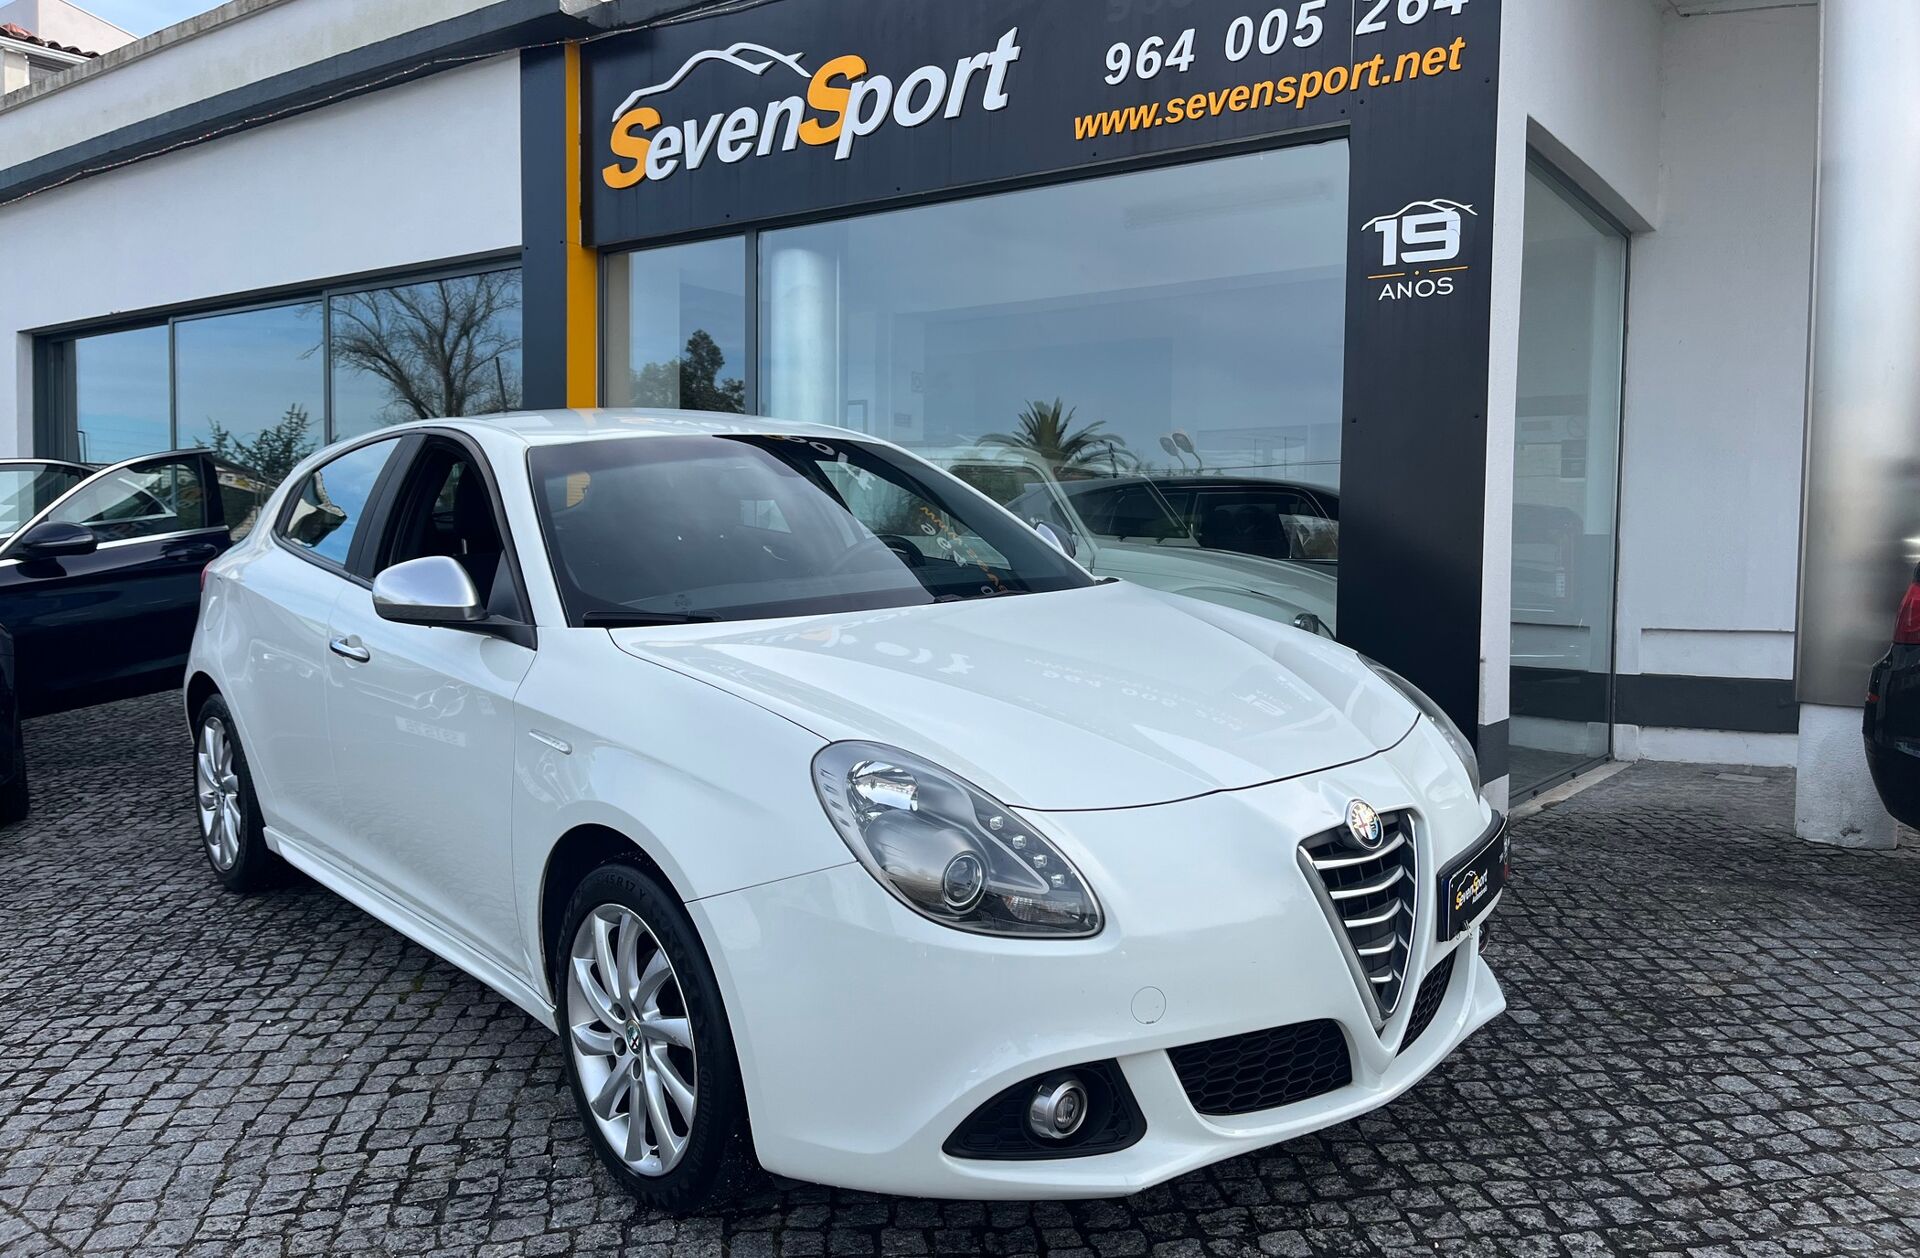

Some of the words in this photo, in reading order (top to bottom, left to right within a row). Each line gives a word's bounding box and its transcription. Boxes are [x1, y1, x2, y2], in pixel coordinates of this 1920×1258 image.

[1104, 28, 1196, 86] 964
[1224, 0, 1326, 62] 005
[602, 27, 1021, 189] SevenSport
[1074, 36, 1466, 140] www.sevensport.net
[1374, 210, 1461, 267] 19
[1378, 277, 1454, 301] ANOS
